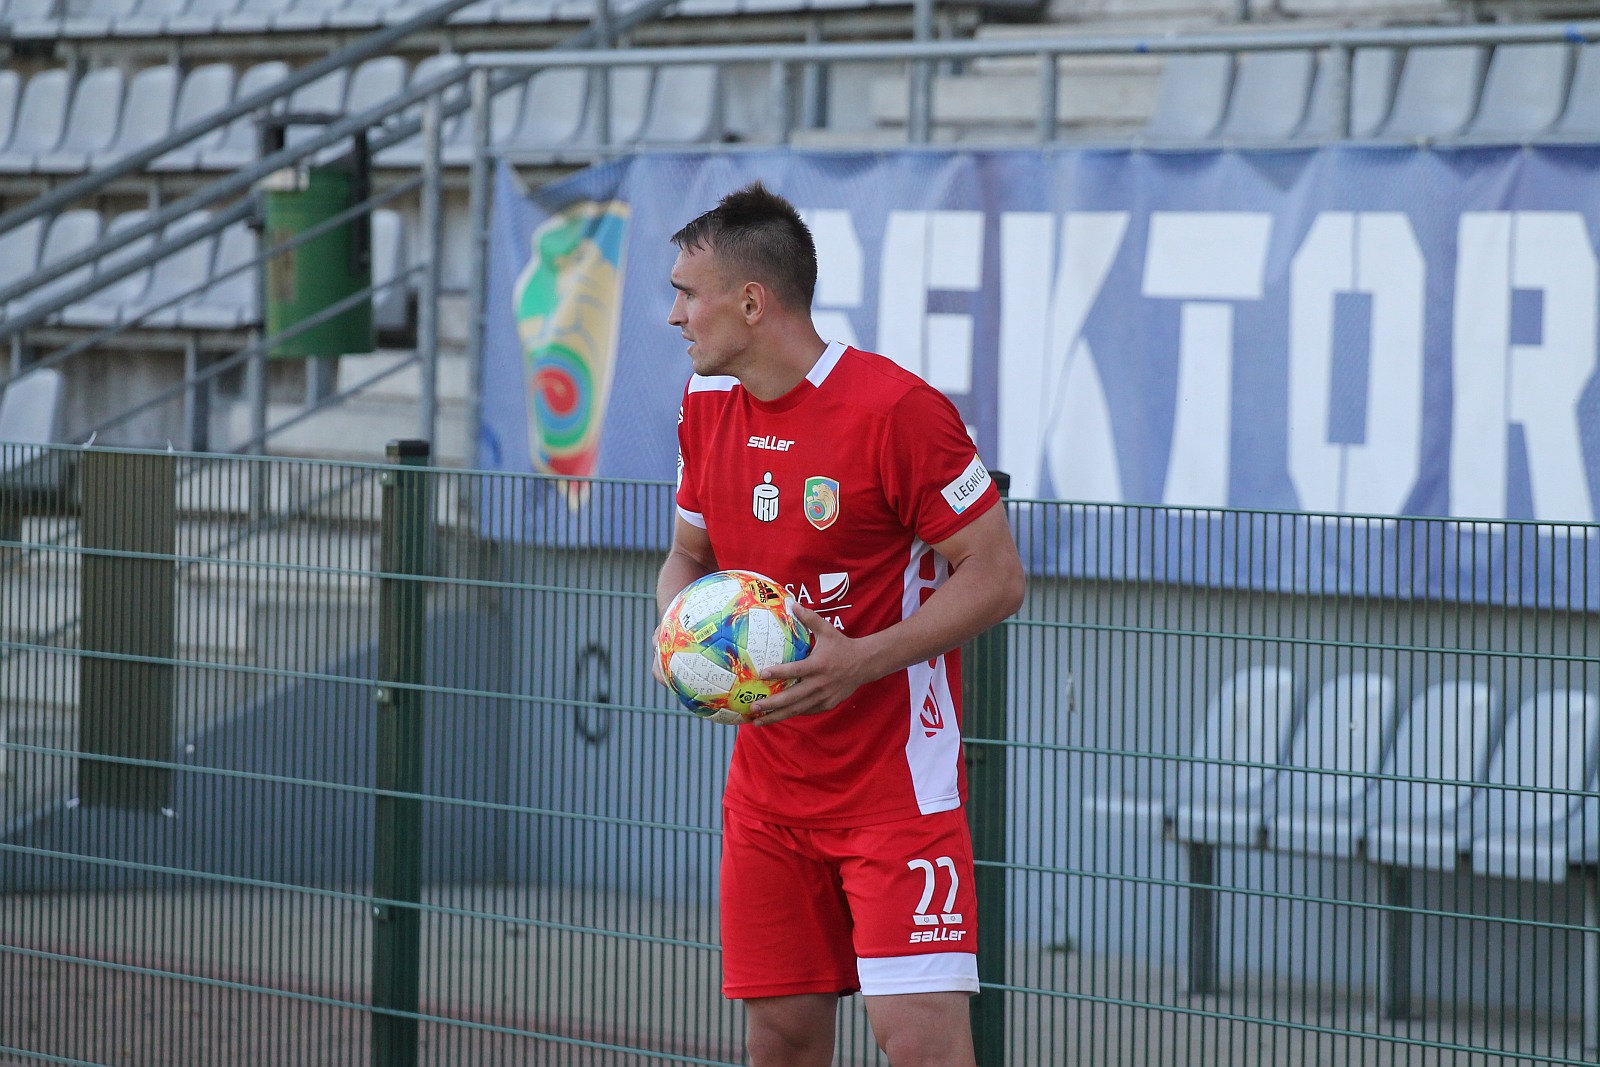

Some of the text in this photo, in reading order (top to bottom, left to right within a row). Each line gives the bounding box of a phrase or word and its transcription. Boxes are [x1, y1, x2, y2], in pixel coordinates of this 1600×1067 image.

[747, 435, 795, 452] saller
[907, 856, 963, 926] 22
[909, 927, 967, 944] saller
